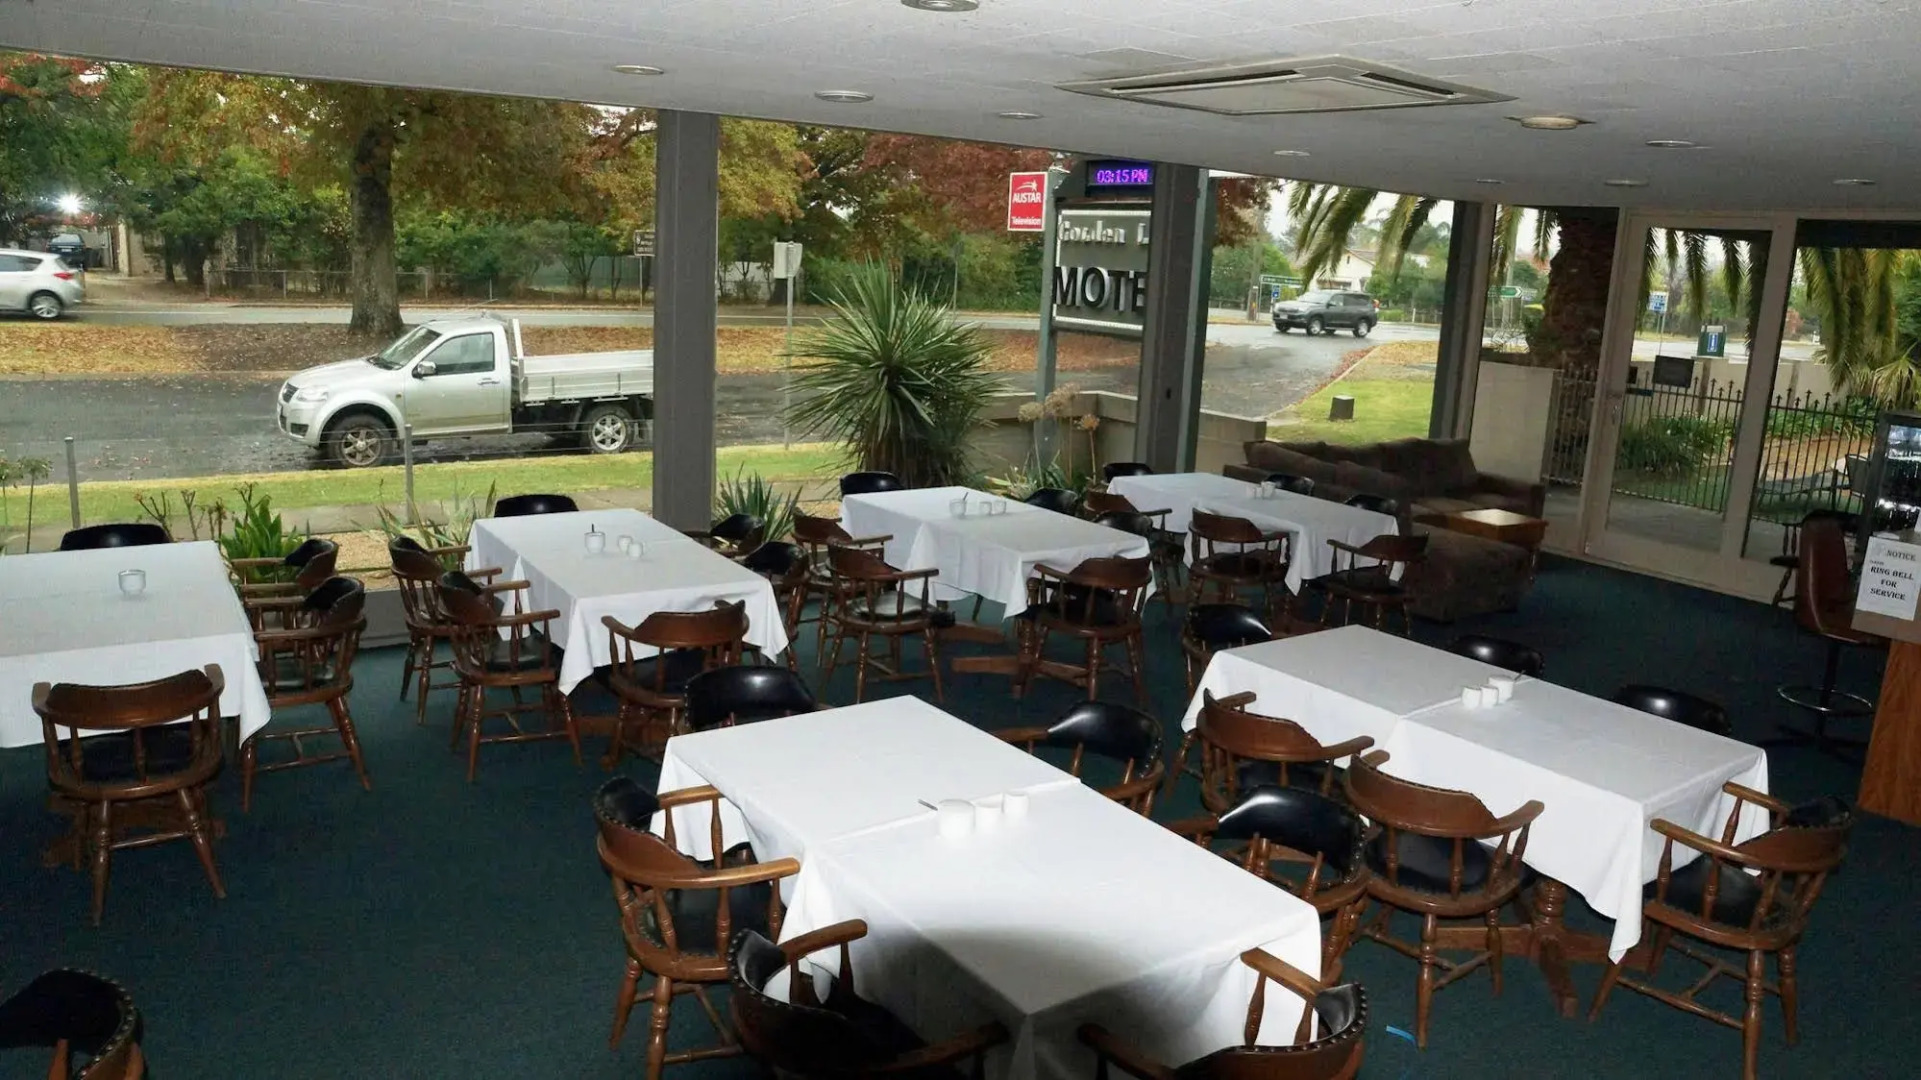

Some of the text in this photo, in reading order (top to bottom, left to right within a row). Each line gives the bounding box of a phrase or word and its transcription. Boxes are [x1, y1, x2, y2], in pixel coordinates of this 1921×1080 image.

[1096, 168, 1149, 183] 03:15 PM
[1012, 191, 1042, 204] AUSTAR
[1011, 215, 1041, 226] Television
[1886, 549, 1917, 562] NOTICE
[1870, 566, 1914, 581] RING BELL
[1880, 579, 1897, 588] FOR
[1870, 588, 1906, 601] SERVICE
